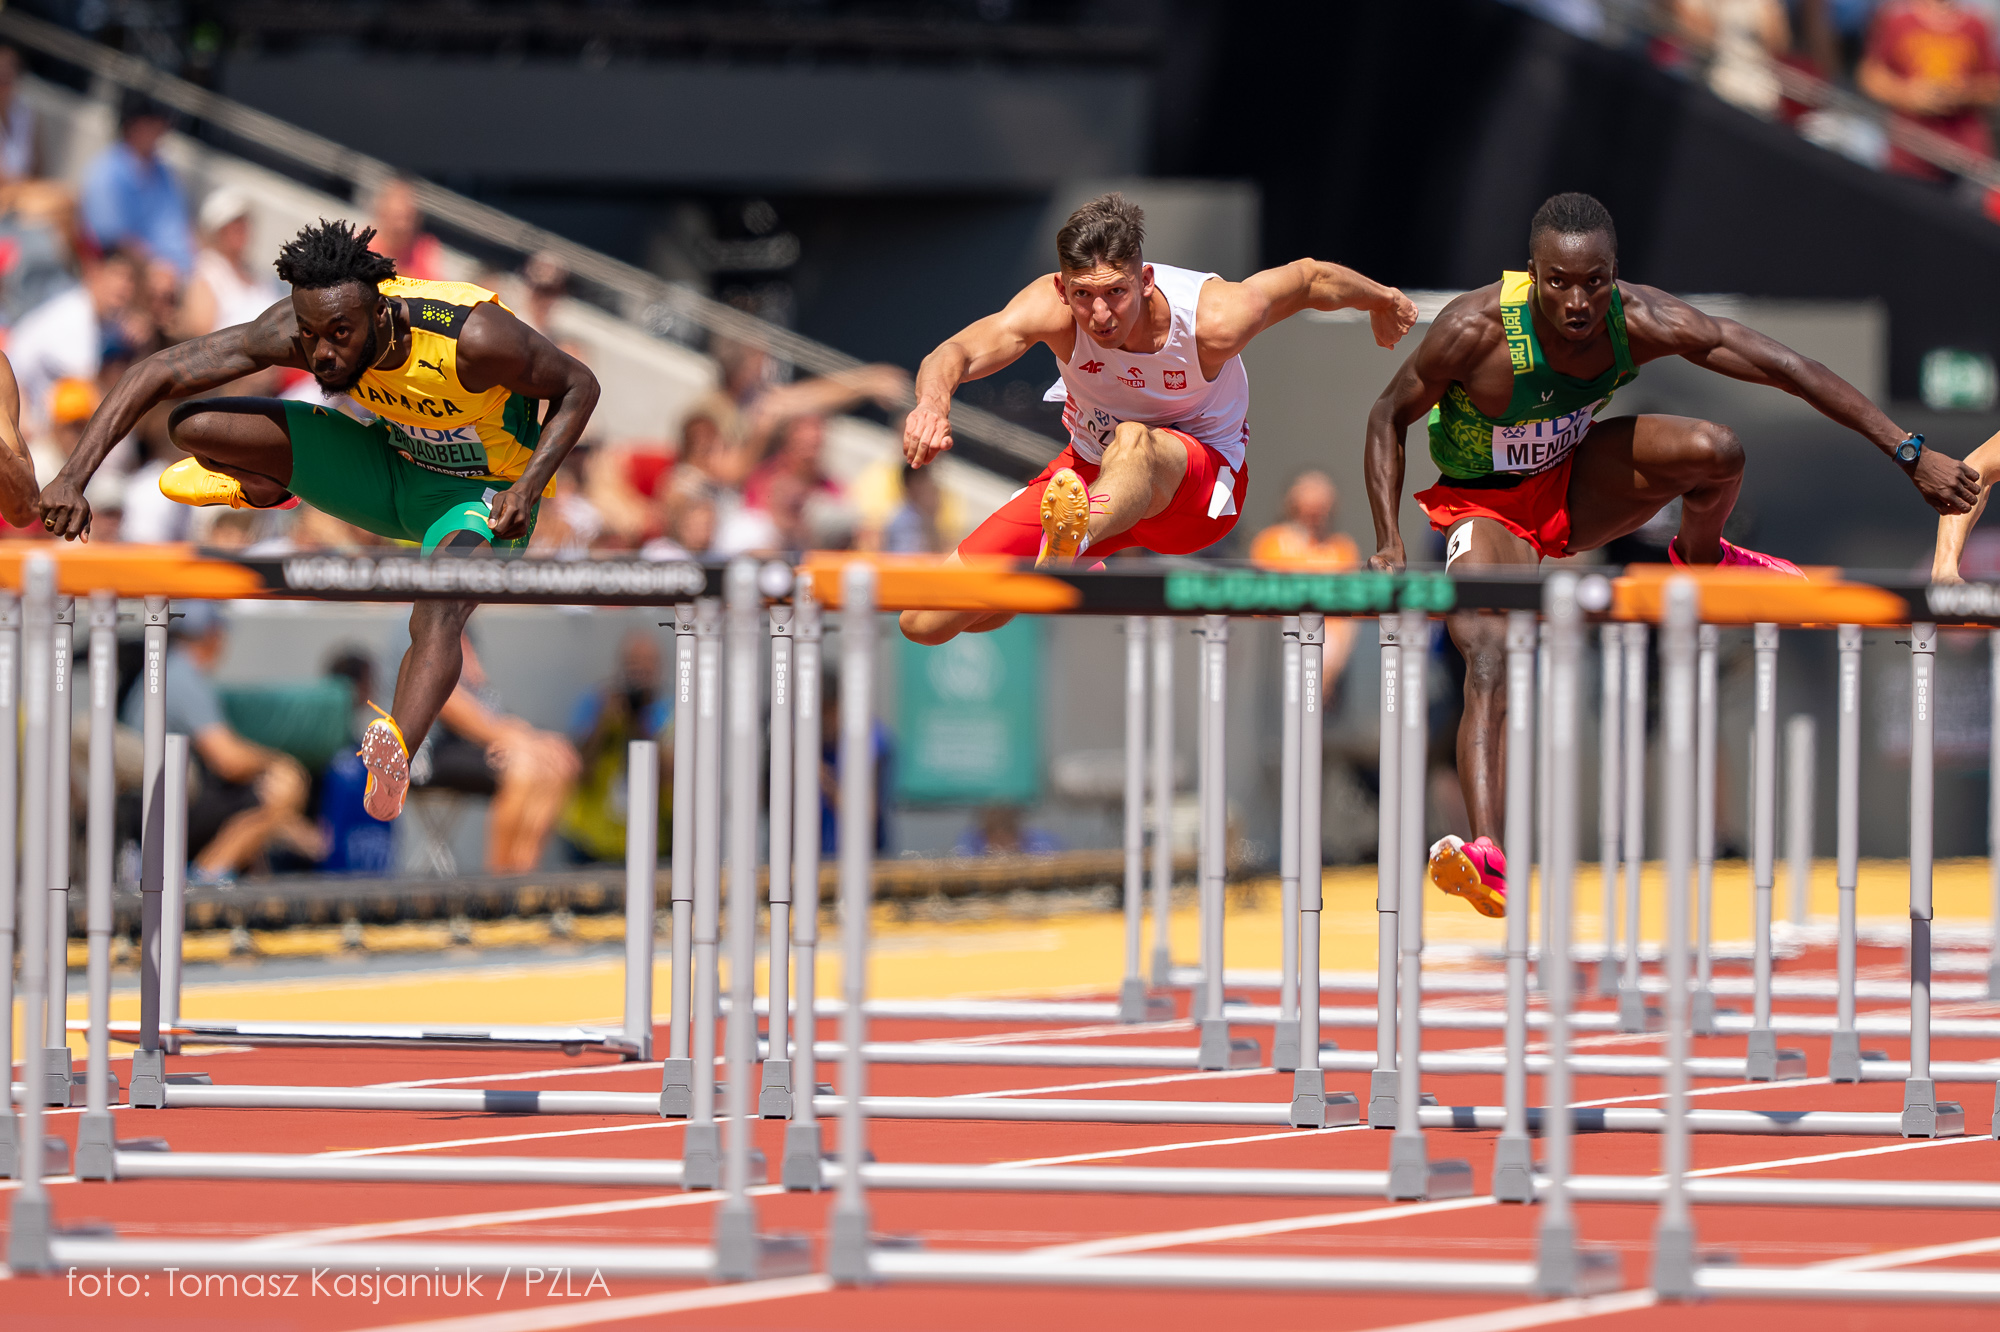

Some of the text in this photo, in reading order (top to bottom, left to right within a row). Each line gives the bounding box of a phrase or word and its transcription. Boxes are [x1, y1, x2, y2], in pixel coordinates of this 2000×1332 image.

[1118, 376, 1143, 387] RLEN
[1507, 419, 1584, 466] MENDY
[55, 650, 66, 692] MONDO
[149, 651, 160, 694] MONDO
[680, 661, 691, 703] MONDO
[775, 663, 786, 705] MONDO
[1305, 670, 1317, 713] MONDO
[1385, 670, 1396, 713] MONDO
[1917, 678, 1928, 721] MONDO
